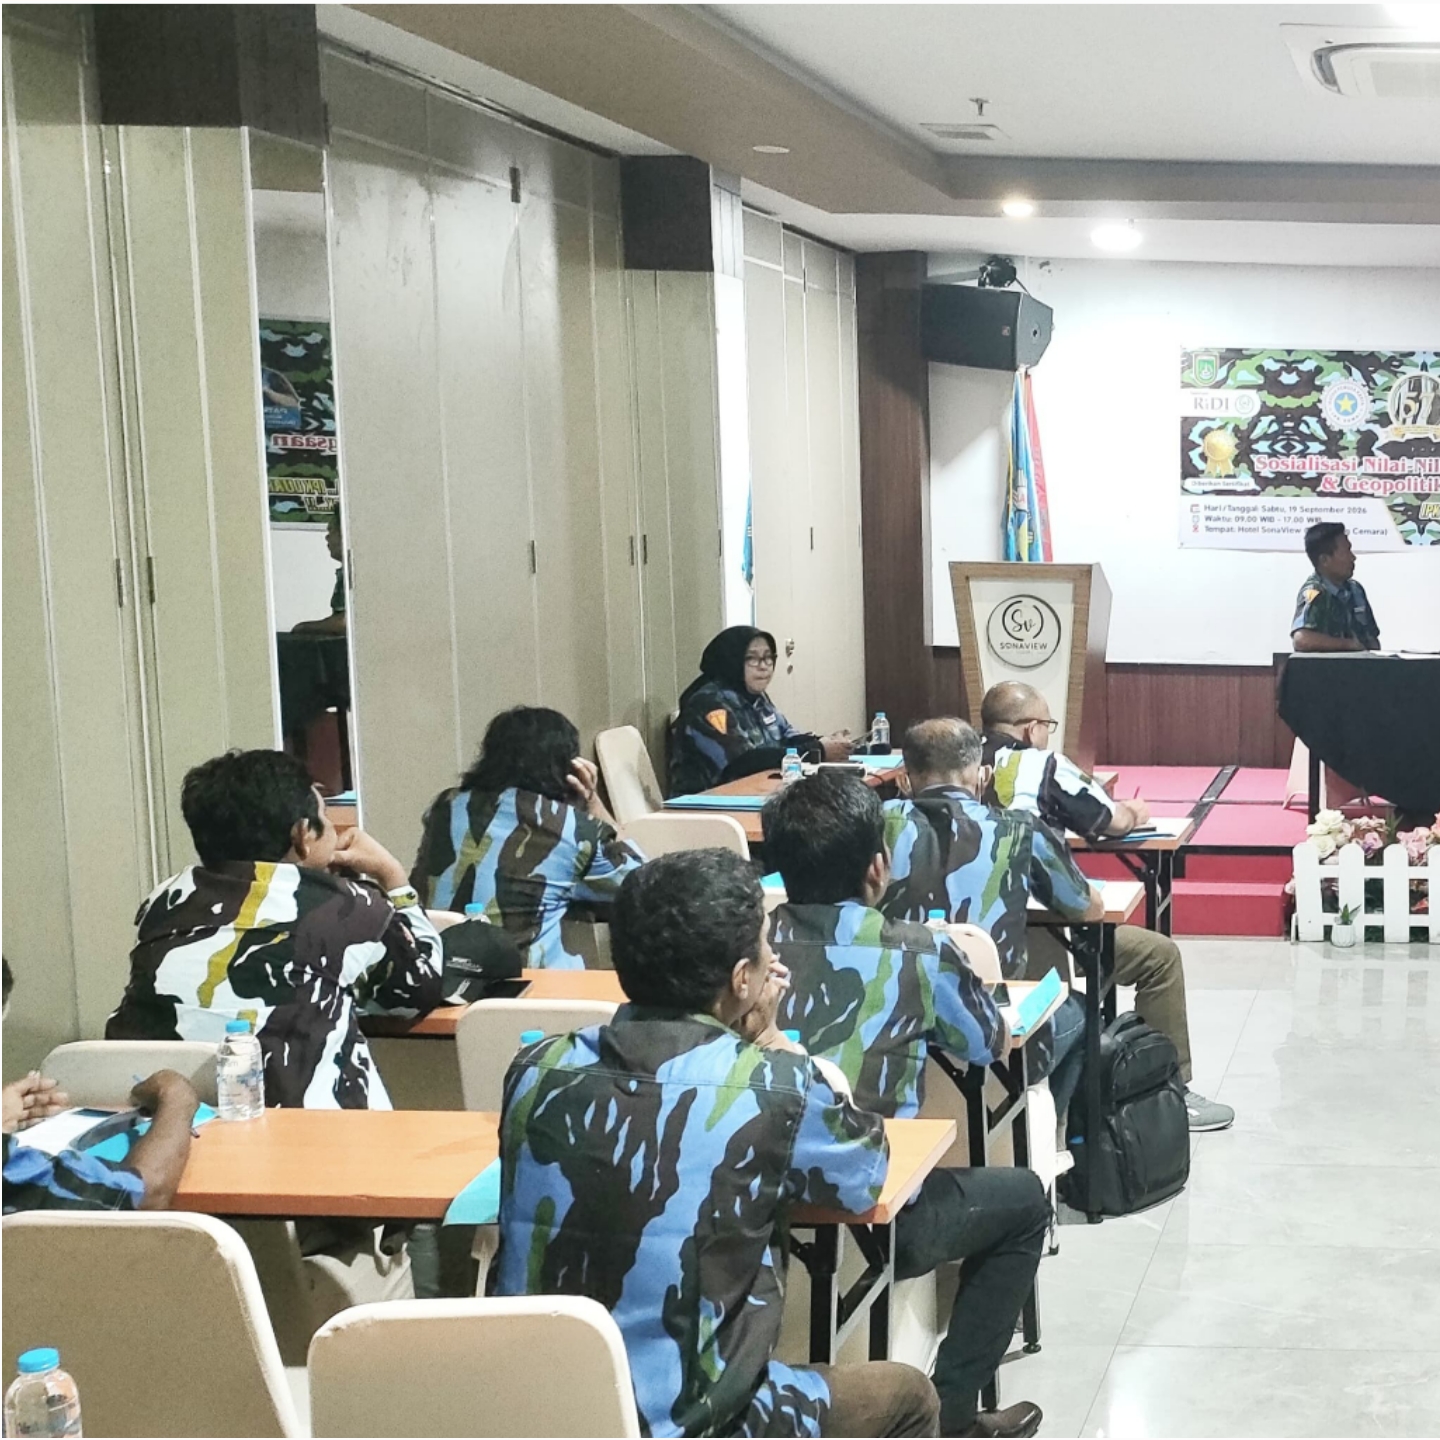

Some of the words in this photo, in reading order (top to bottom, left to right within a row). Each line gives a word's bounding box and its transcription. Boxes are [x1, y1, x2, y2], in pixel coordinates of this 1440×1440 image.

[1402, 392, 1435, 420] 57
[1255, 456, 1358, 471] Sosialisasi
[1321, 476, 1338, 491] &
[1261, 505, 1287, 514] Sabtu,
[1299, 505, 1344, 515] September
[1346, 506, 1367, 514] 2026
[1204, 515, 1232, 523] Waktu:
[1237, 526, 1260, 534] Hotel
[1261, 526, 1302, 534] SonaView
[1352, 528, 1388, 536] Cemara)
[999, 642, 1048, 650] SONAVIEW
